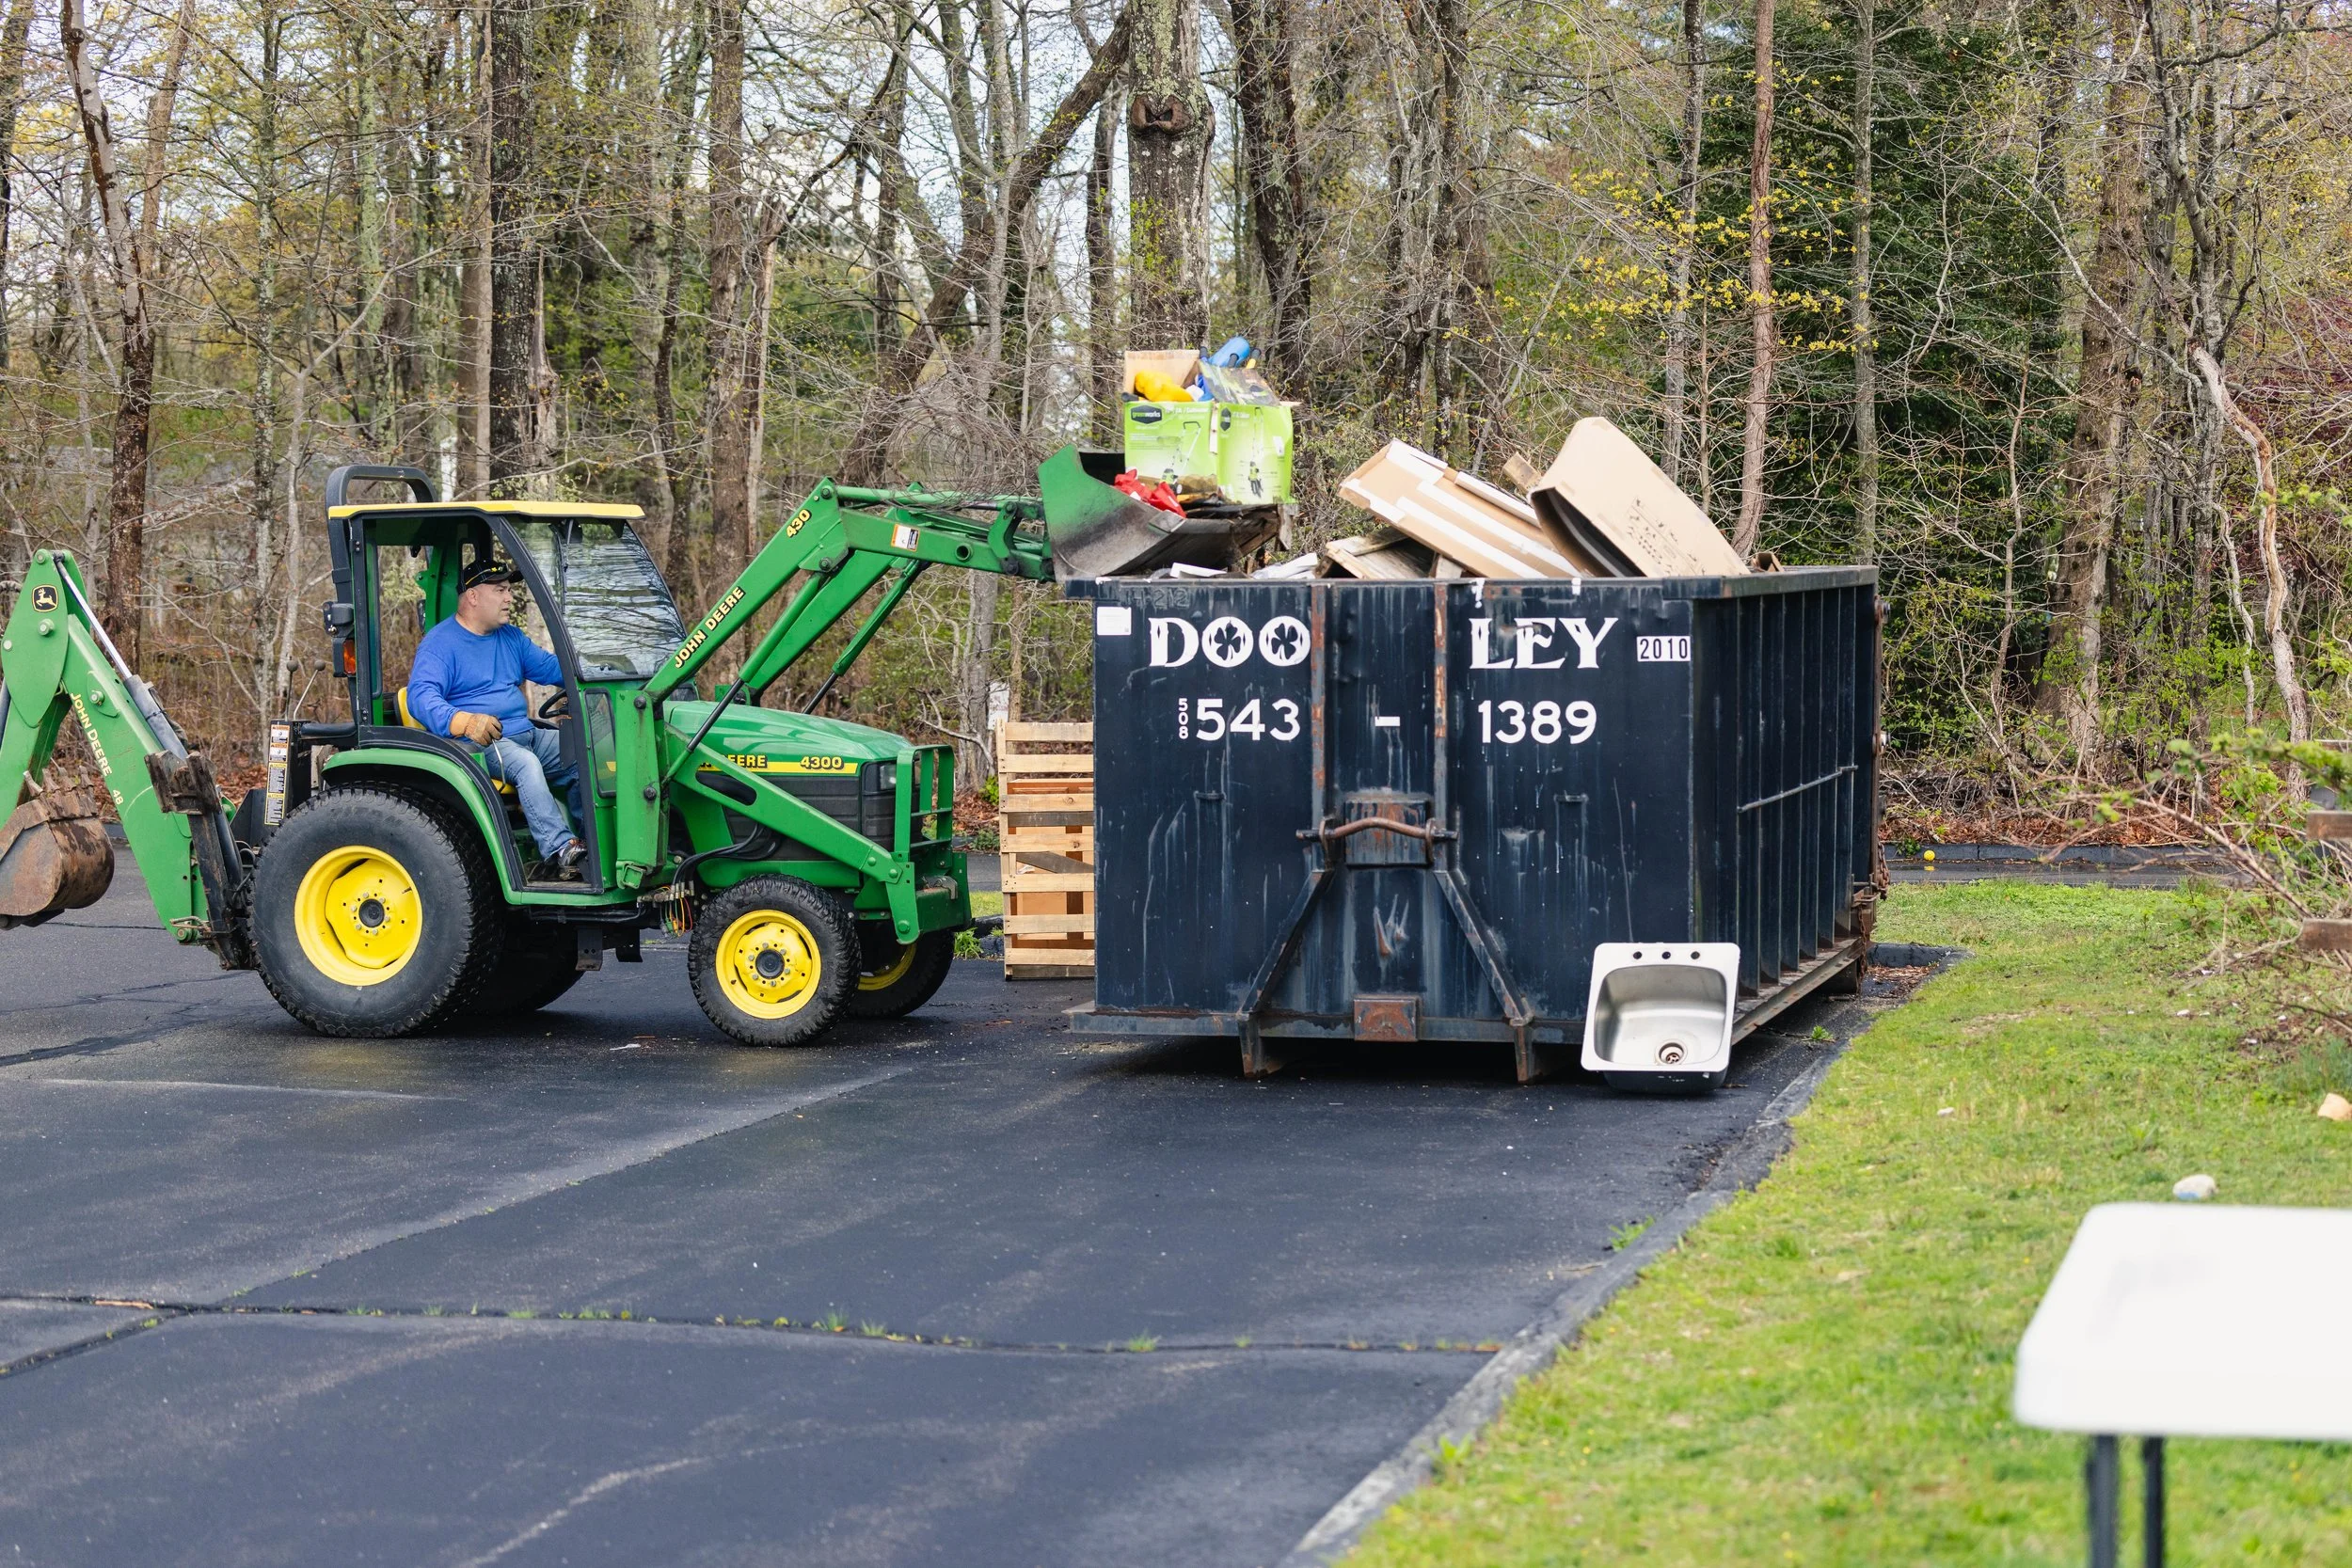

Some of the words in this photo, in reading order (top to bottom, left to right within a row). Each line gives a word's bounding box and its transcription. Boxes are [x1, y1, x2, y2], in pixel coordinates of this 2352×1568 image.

[787, 509, 811, 538] 430
[674, 629, 707, 669] JOHN
[705, 586, 746, 631] DEERE
[1148, 615, 1311, 668] DOO
[1468, 617, 1619, 669] LEY
[1639, 638, 1689, 660] 2010
[70, 692, 92, 729] JOHN
[87, 728, 113, 777] DEERE
[1178, 698, 1189, 739] 508
[1196, 698, 1301, 741] 543
[1477, 700, 1597, 745] 1389
[727, 754, 768, 768] EERE
[800, 755, 845, 770] 4300
[112, 789, 124, 805] 48
